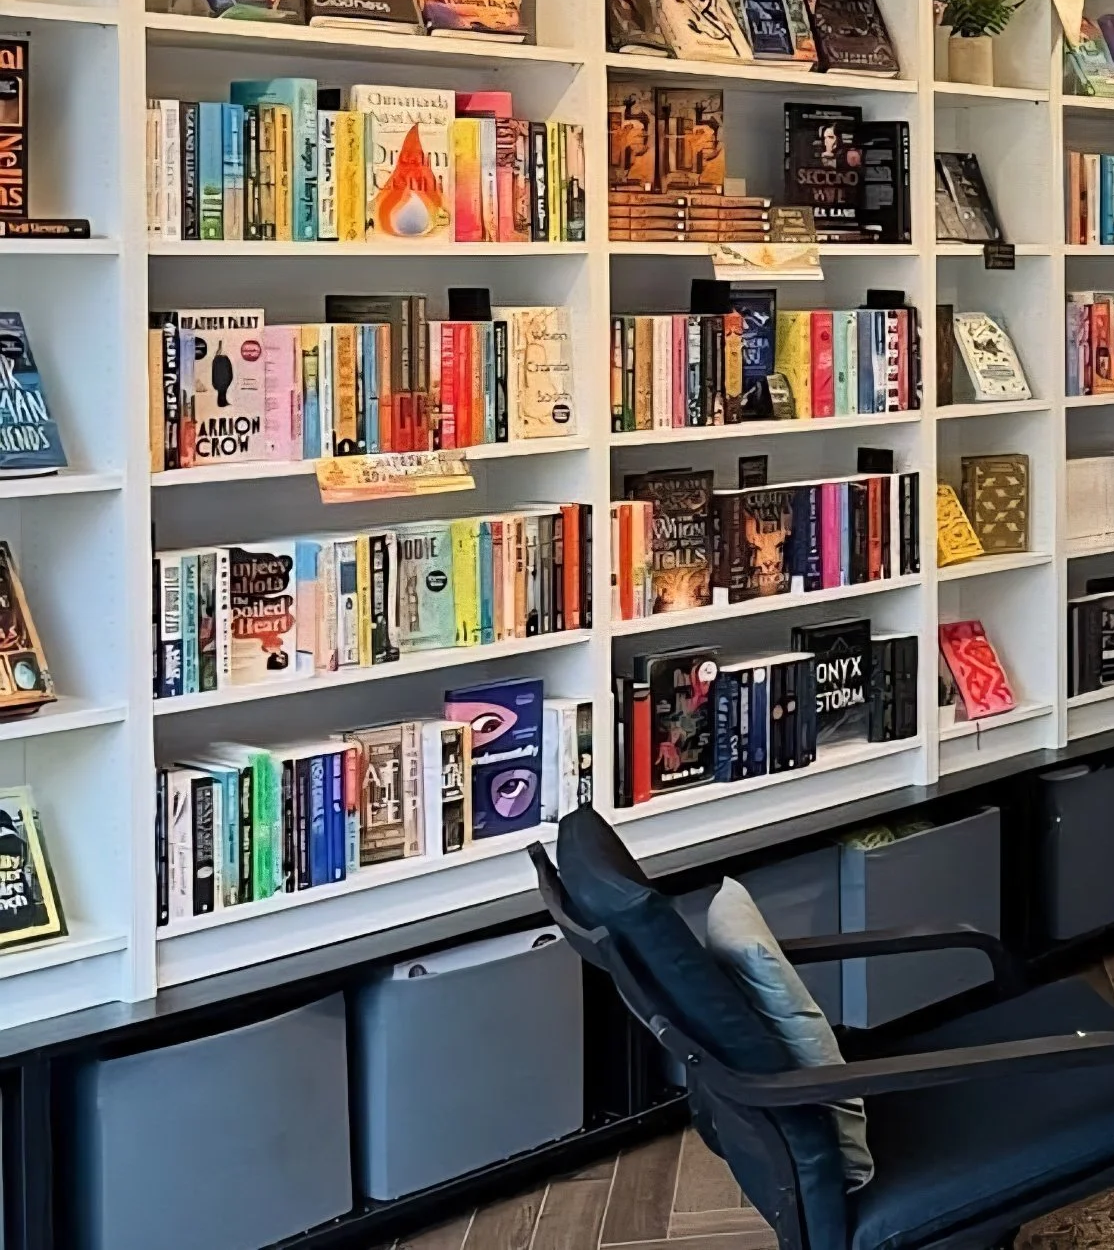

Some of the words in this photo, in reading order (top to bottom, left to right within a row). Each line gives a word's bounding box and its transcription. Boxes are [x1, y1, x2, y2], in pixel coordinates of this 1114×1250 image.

[197, 415, 260, 438] ARRION
[196, 436, 250, 458] CROW
[816, 655, 863, 684] ONYX
[815, 685, 866, 714] STORM
